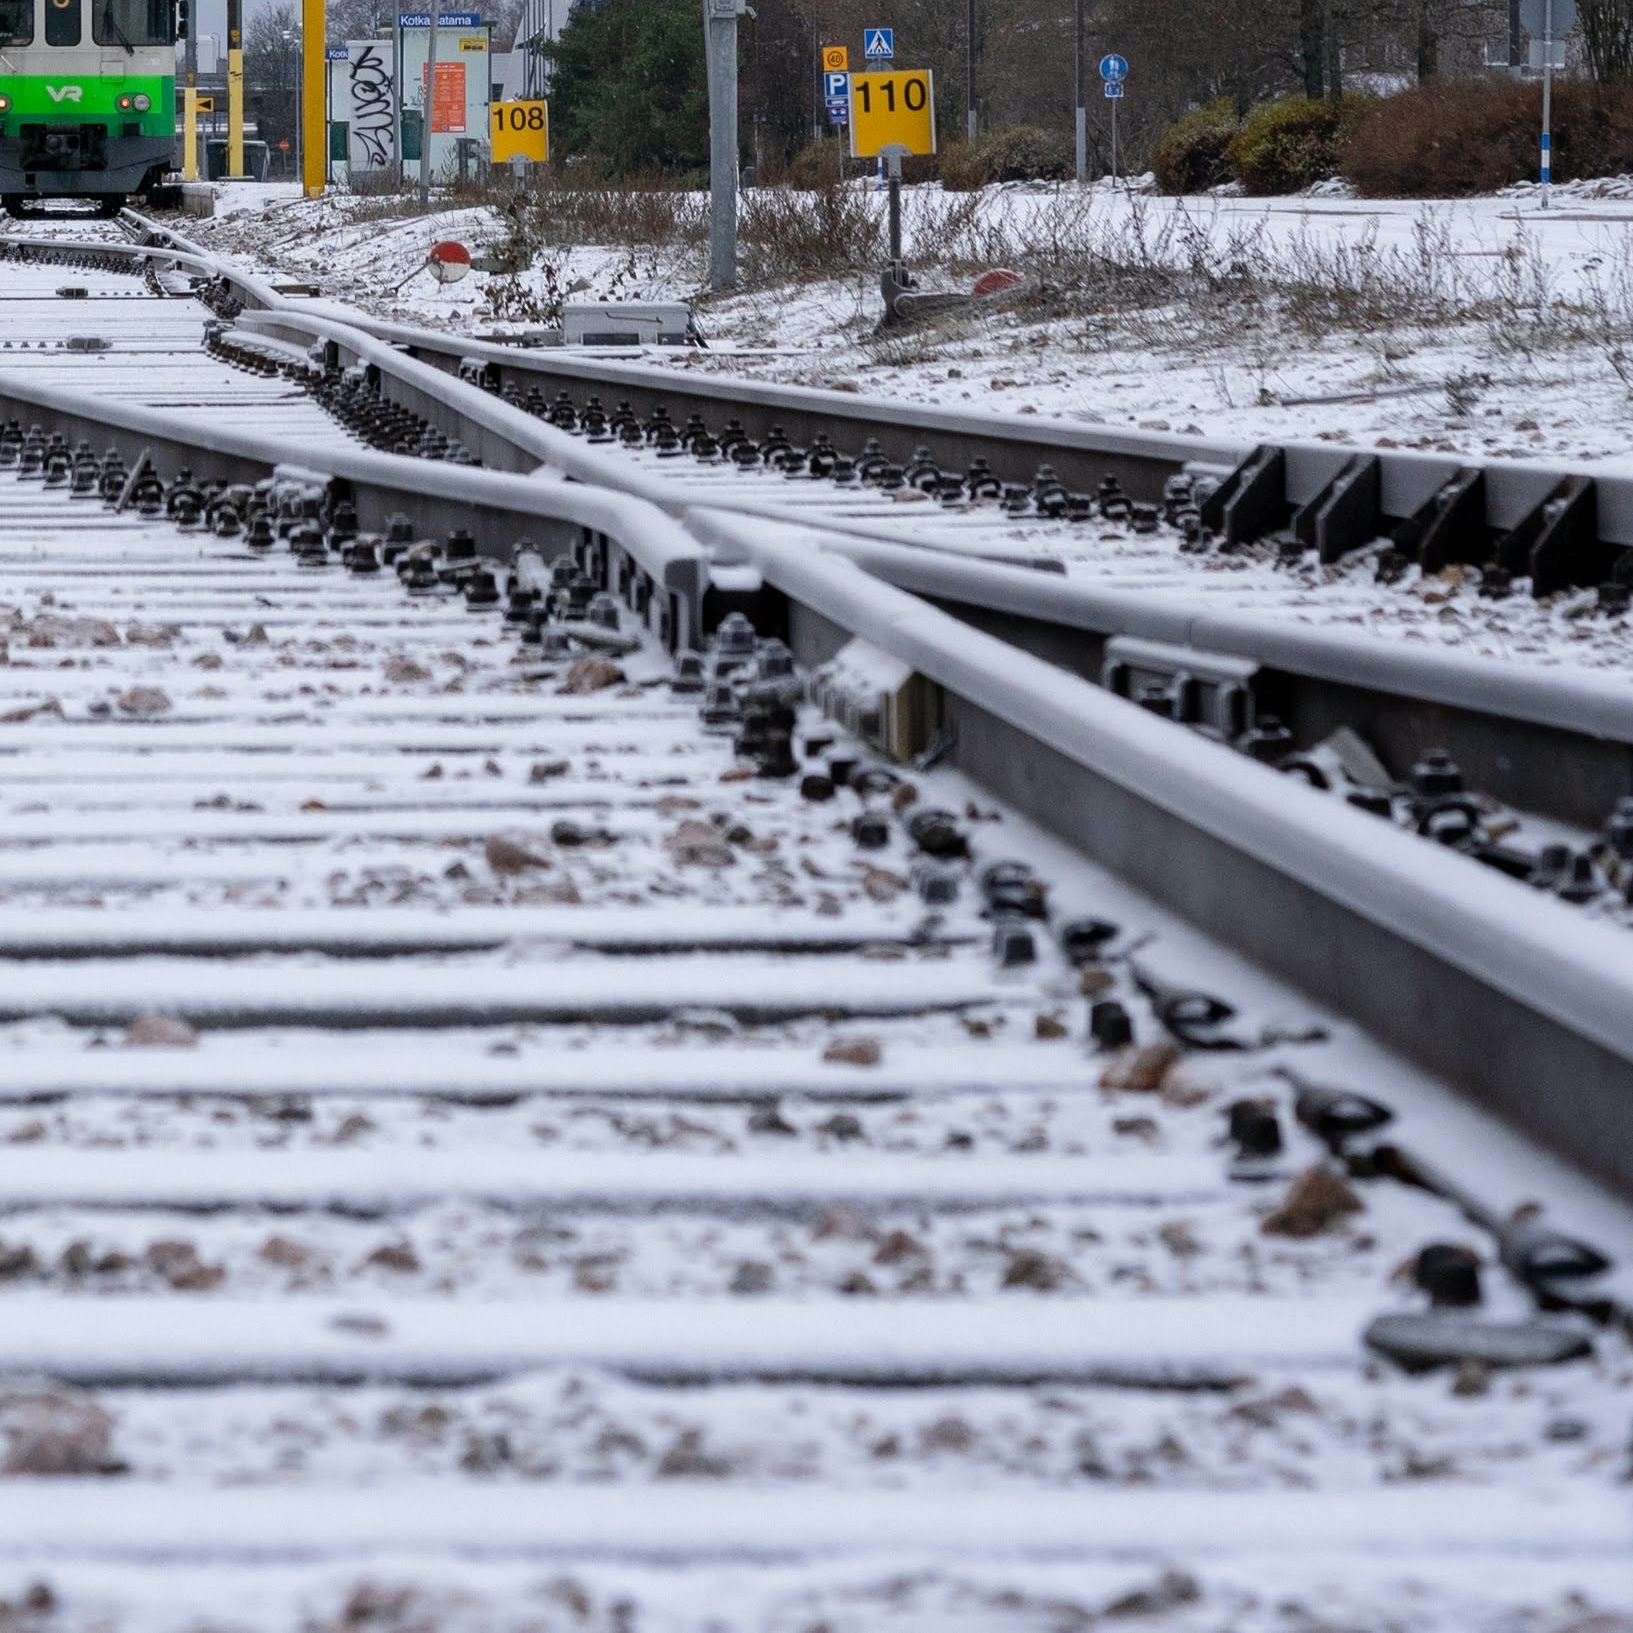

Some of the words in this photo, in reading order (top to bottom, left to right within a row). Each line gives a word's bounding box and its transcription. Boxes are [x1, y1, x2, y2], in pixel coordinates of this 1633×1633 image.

[400, 16, 431, 26] Kotka
[437, 17, 472, 26] atama
[830, 55, 841, 64] 40
[45, 85, 83, 102] VR
[829, 74, 846, 95] P
[855, 78, 927, 113] 110
[492, 106, 545, 131] 108
